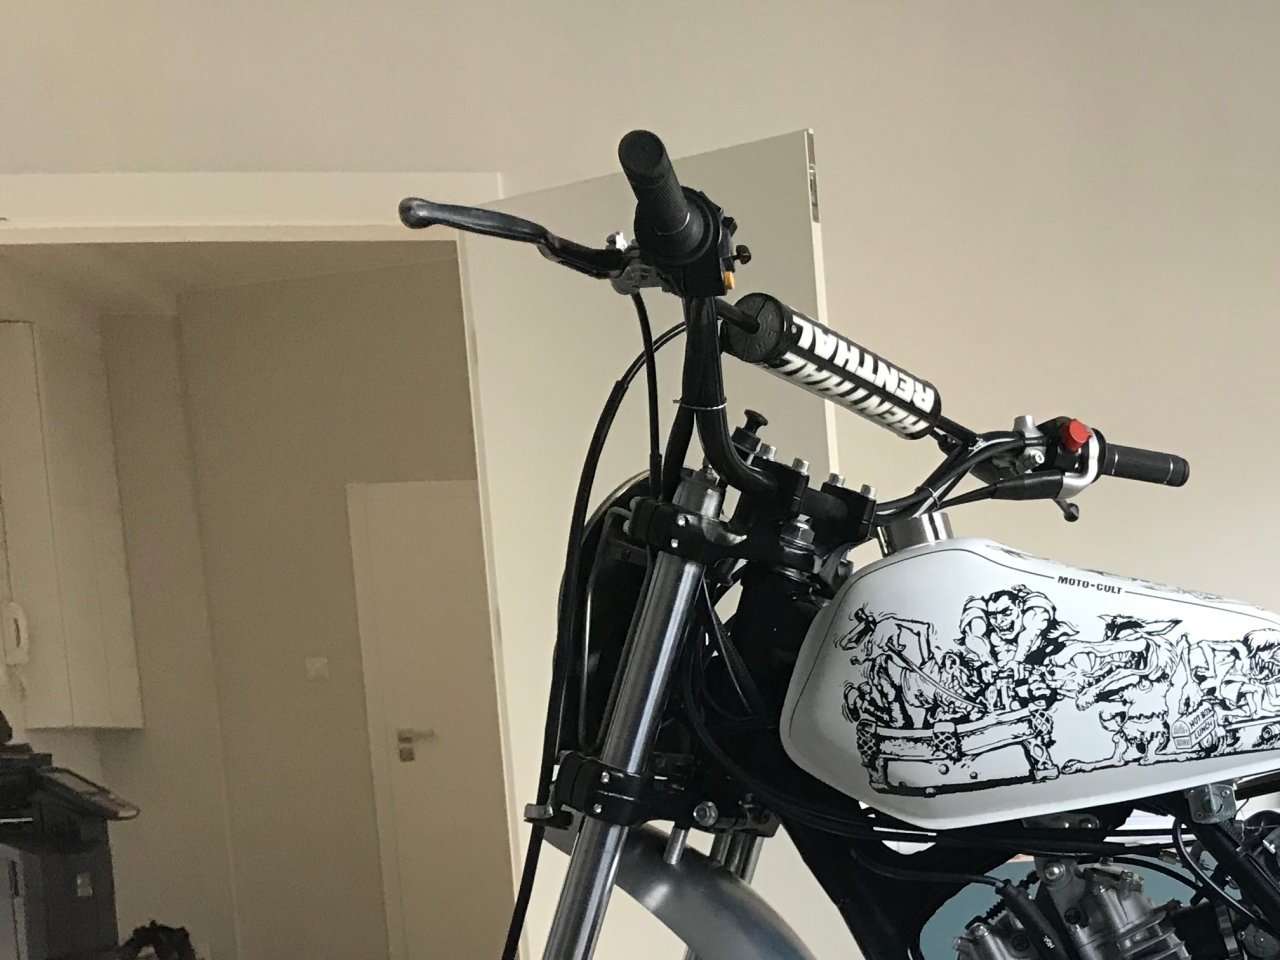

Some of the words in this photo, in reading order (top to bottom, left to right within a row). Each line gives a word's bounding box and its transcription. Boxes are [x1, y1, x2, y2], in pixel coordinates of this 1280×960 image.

[774, 351, 930, 435] RENTHAL
[792, 314, 935, 413] RENTHAL
[1194, 720, 1213, 740] LUNCH
